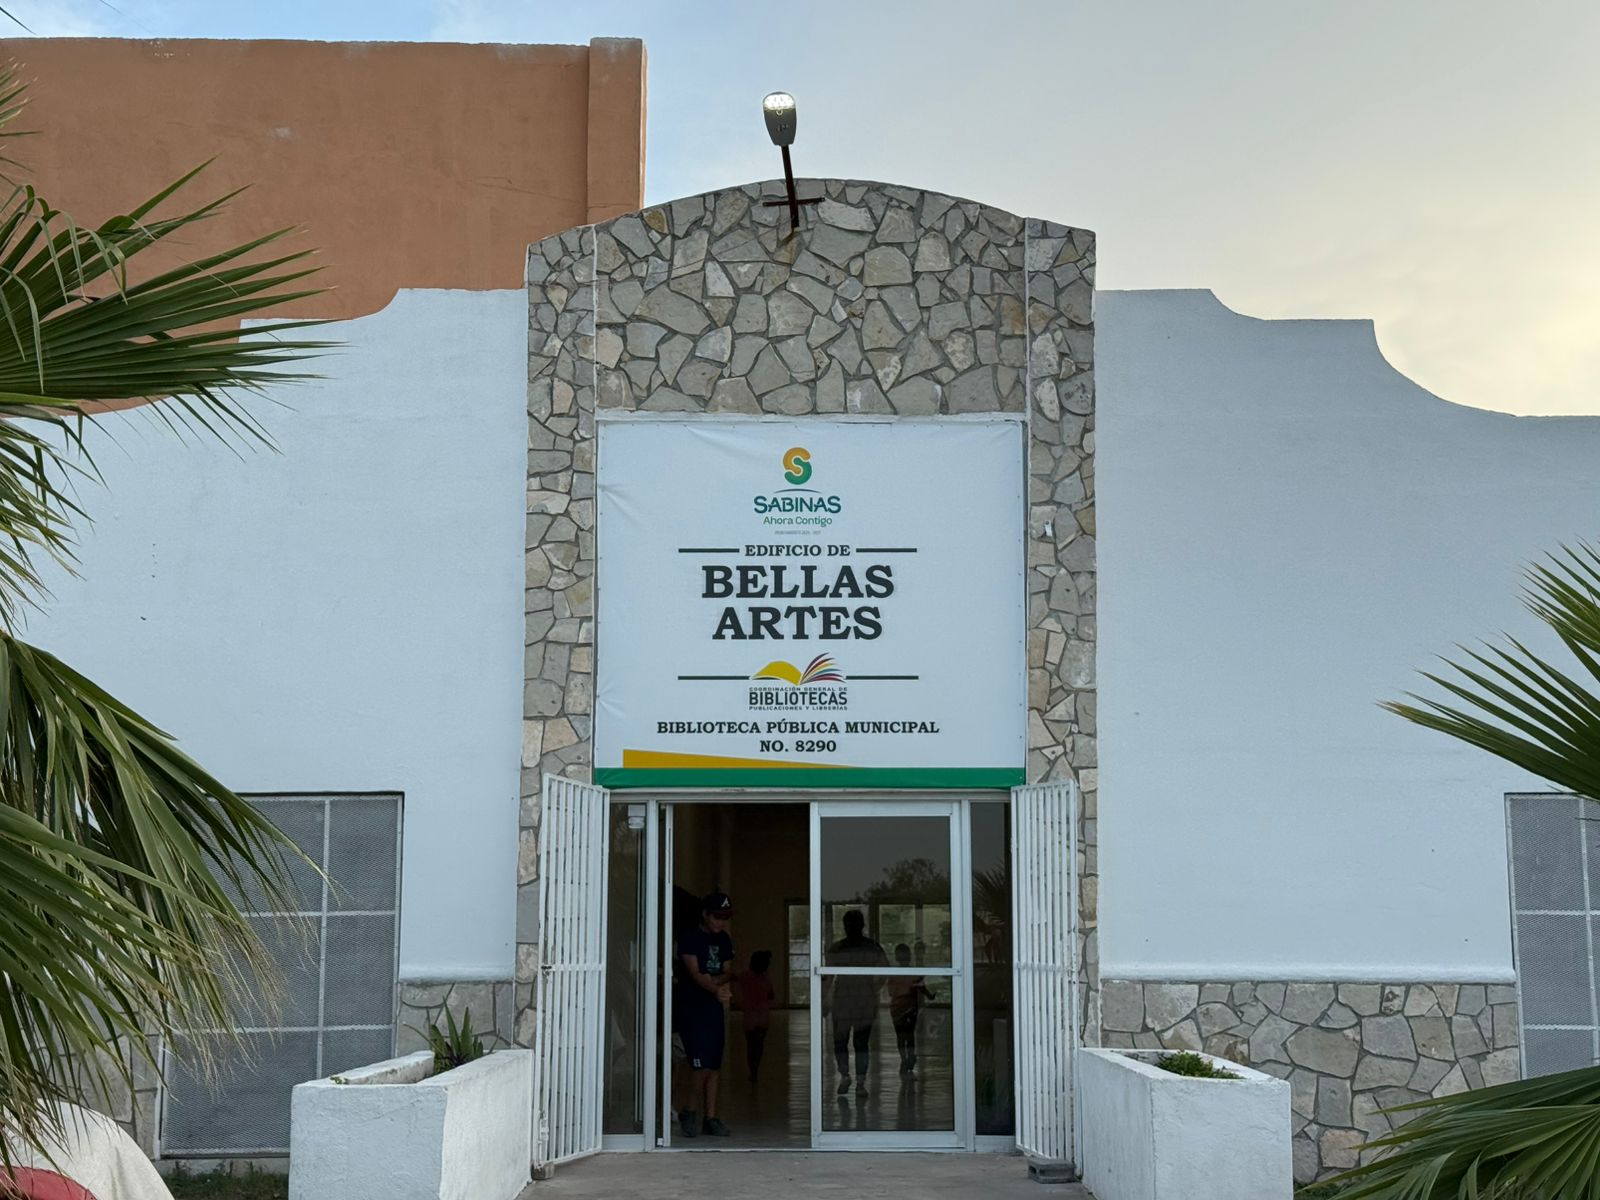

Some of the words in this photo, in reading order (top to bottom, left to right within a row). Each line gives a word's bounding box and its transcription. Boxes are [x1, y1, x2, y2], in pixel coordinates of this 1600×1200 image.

[754, 496, 841, 514] SABINAS
[763, 516, 793, 525] Ahora
[795, 516, 832, 528] Contigo
[745, 545, 821, 557] EDIFICIO
[827, 545, 850, 557] DE
[702, 565, 894, 598] BELLAS
[712, 606, 882, 640] ARTES
[749, 692, 848, 705] BIBLIOTECAS
[657, 721, 761, 734] BIBLIOTECA
[766, 718, 840, 734] PÚBLICA
[845, 721, 940, 734] MUNICIPAL
[760, 740, 789, 753] NO.
[795, 740, 836, 753] 8290
